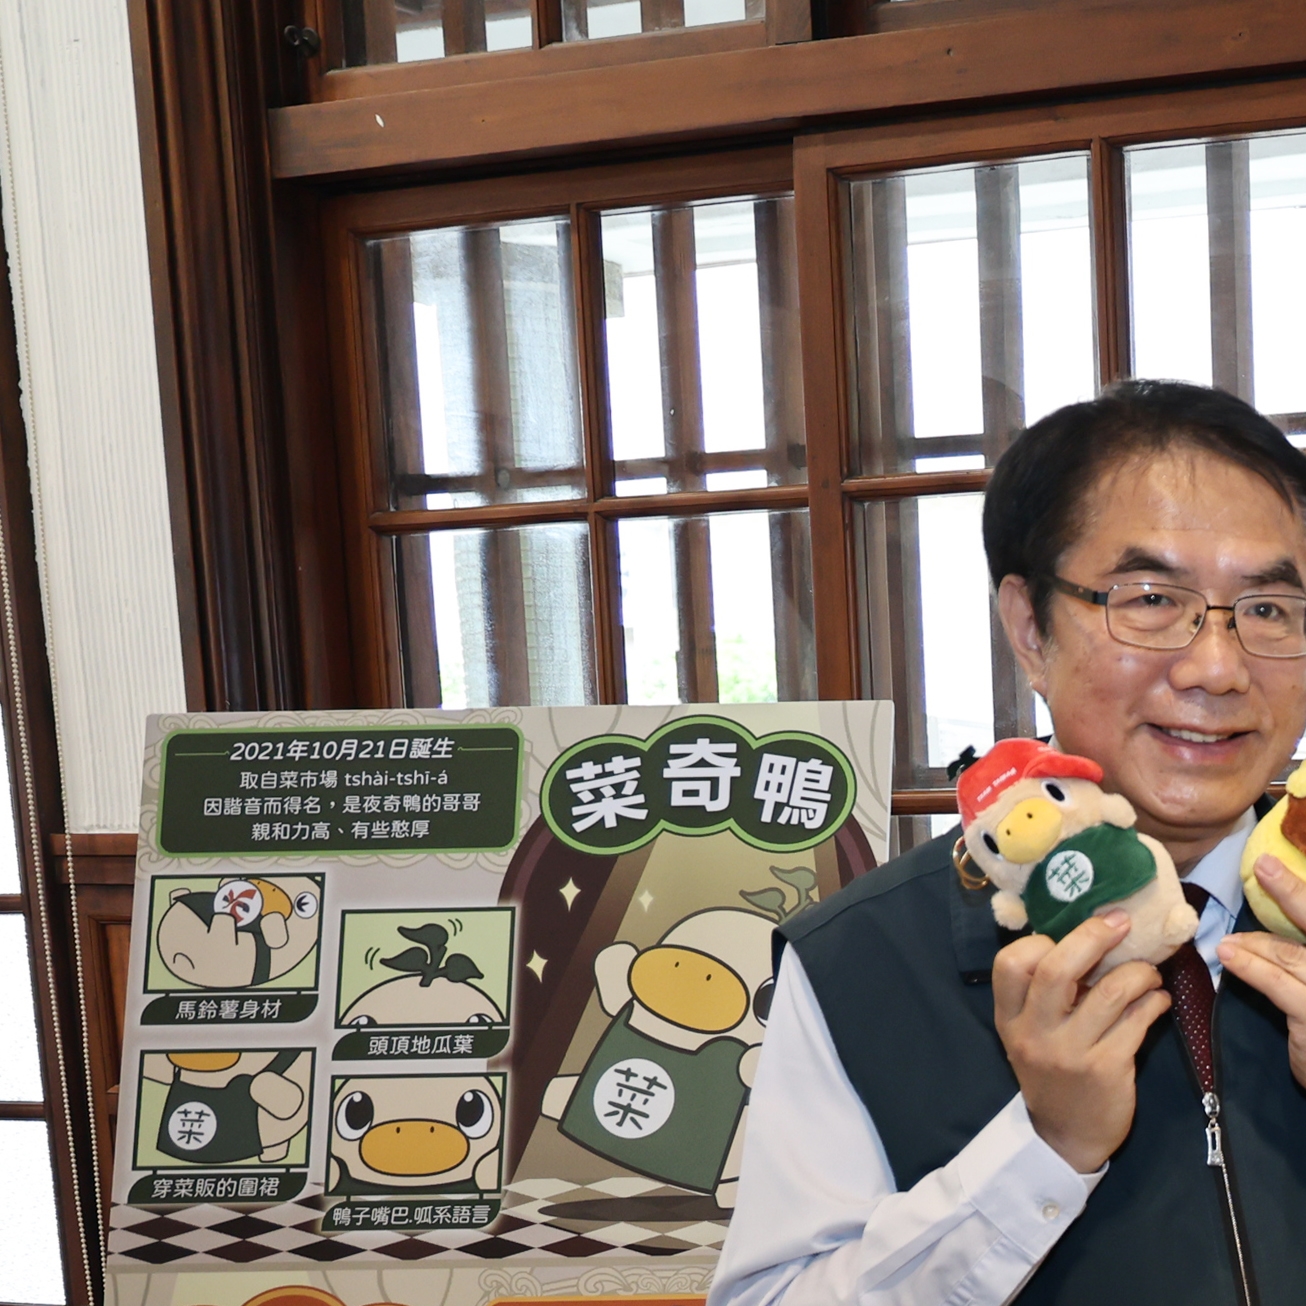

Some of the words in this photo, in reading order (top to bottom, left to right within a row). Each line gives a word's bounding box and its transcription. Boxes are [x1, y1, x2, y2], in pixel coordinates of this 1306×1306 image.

[229, 737, 455, 761] 2021年10月21日誕生
[238, 770, 338, 790] 取自菜市場
[565, 737, 834, 833] 菜奇鴨
[202, 792, 482, 816] 因諧音而得名，是夜奇鴨的哥哥
[250, 819, 431, 841] 親和力高、有些憨厚
[1047, 853, 1090, 898] 菜
[174, 999, 282, 1021] 馬鈴薯身材
[367, 1034, 475, 1055] 頭頂地瓜葉
[603, 1066, 668, 1131] 菜
[176, 1108, 211, 1145] 菜
[150, 1175, 281, 1199] 穿菜販的圍裙
[332, 1203, 492, 1227] 鴨子嘴巴.呱系語言
